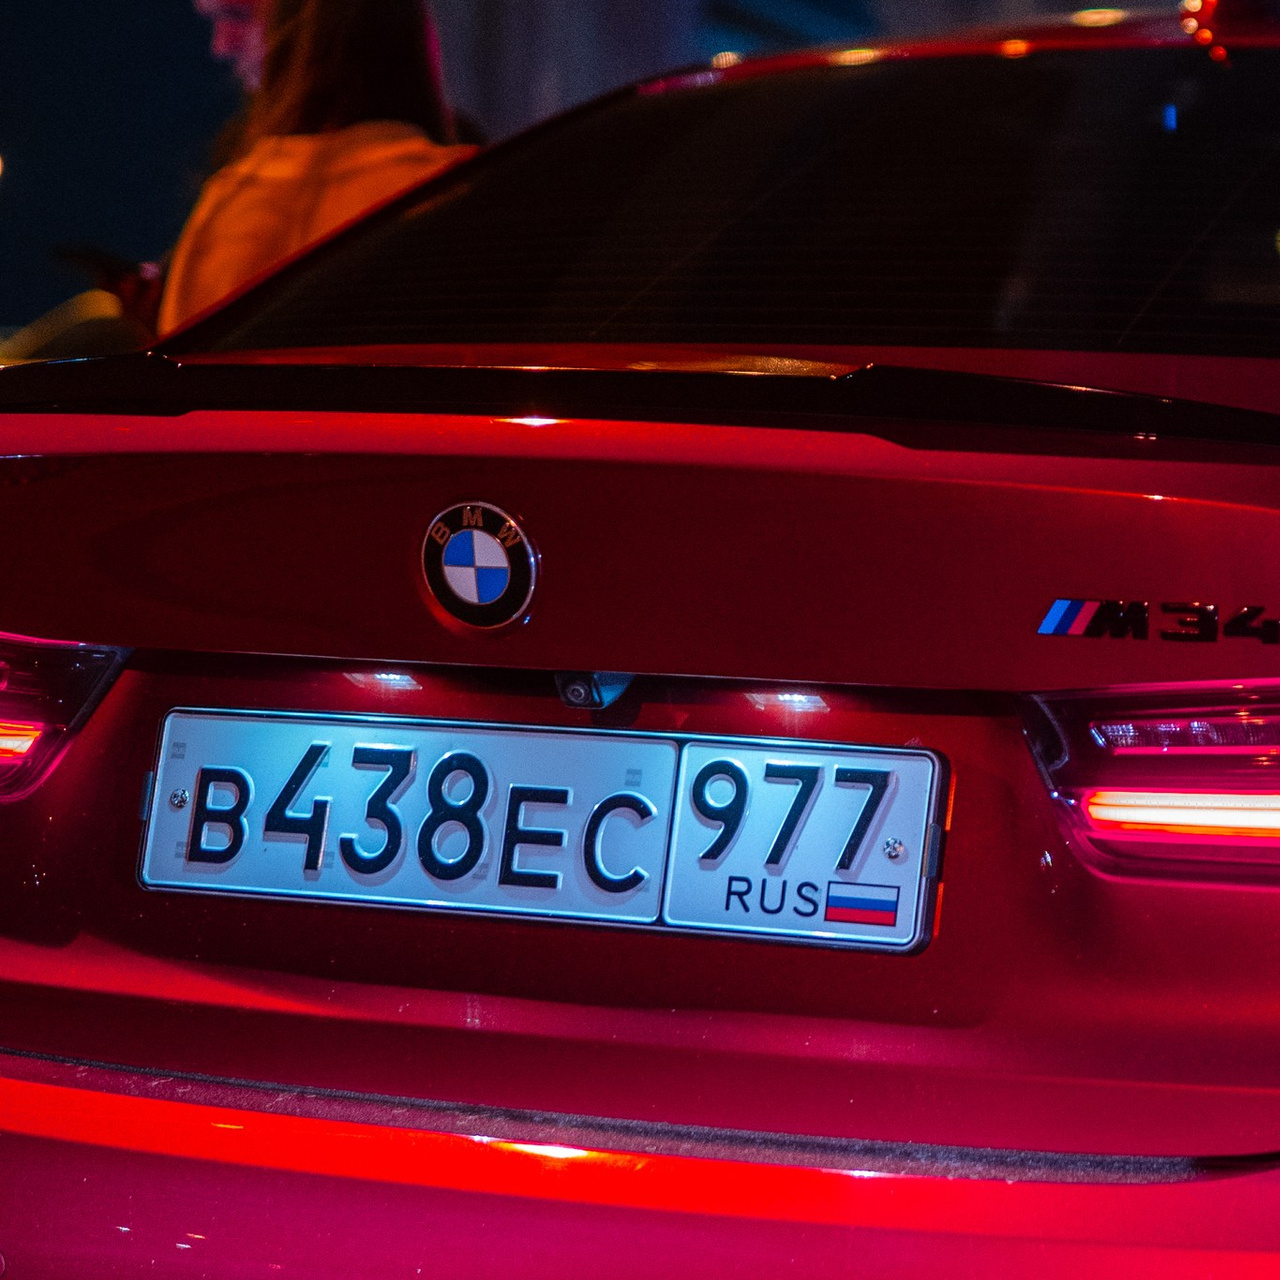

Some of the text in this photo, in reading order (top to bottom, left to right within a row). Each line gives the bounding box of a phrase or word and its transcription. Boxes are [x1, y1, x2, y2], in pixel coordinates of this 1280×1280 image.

[431, 507, 521, 548] BMW
[186, 741, 893, 893] B438EC 977
[725, 875, 820, 917] RUS
